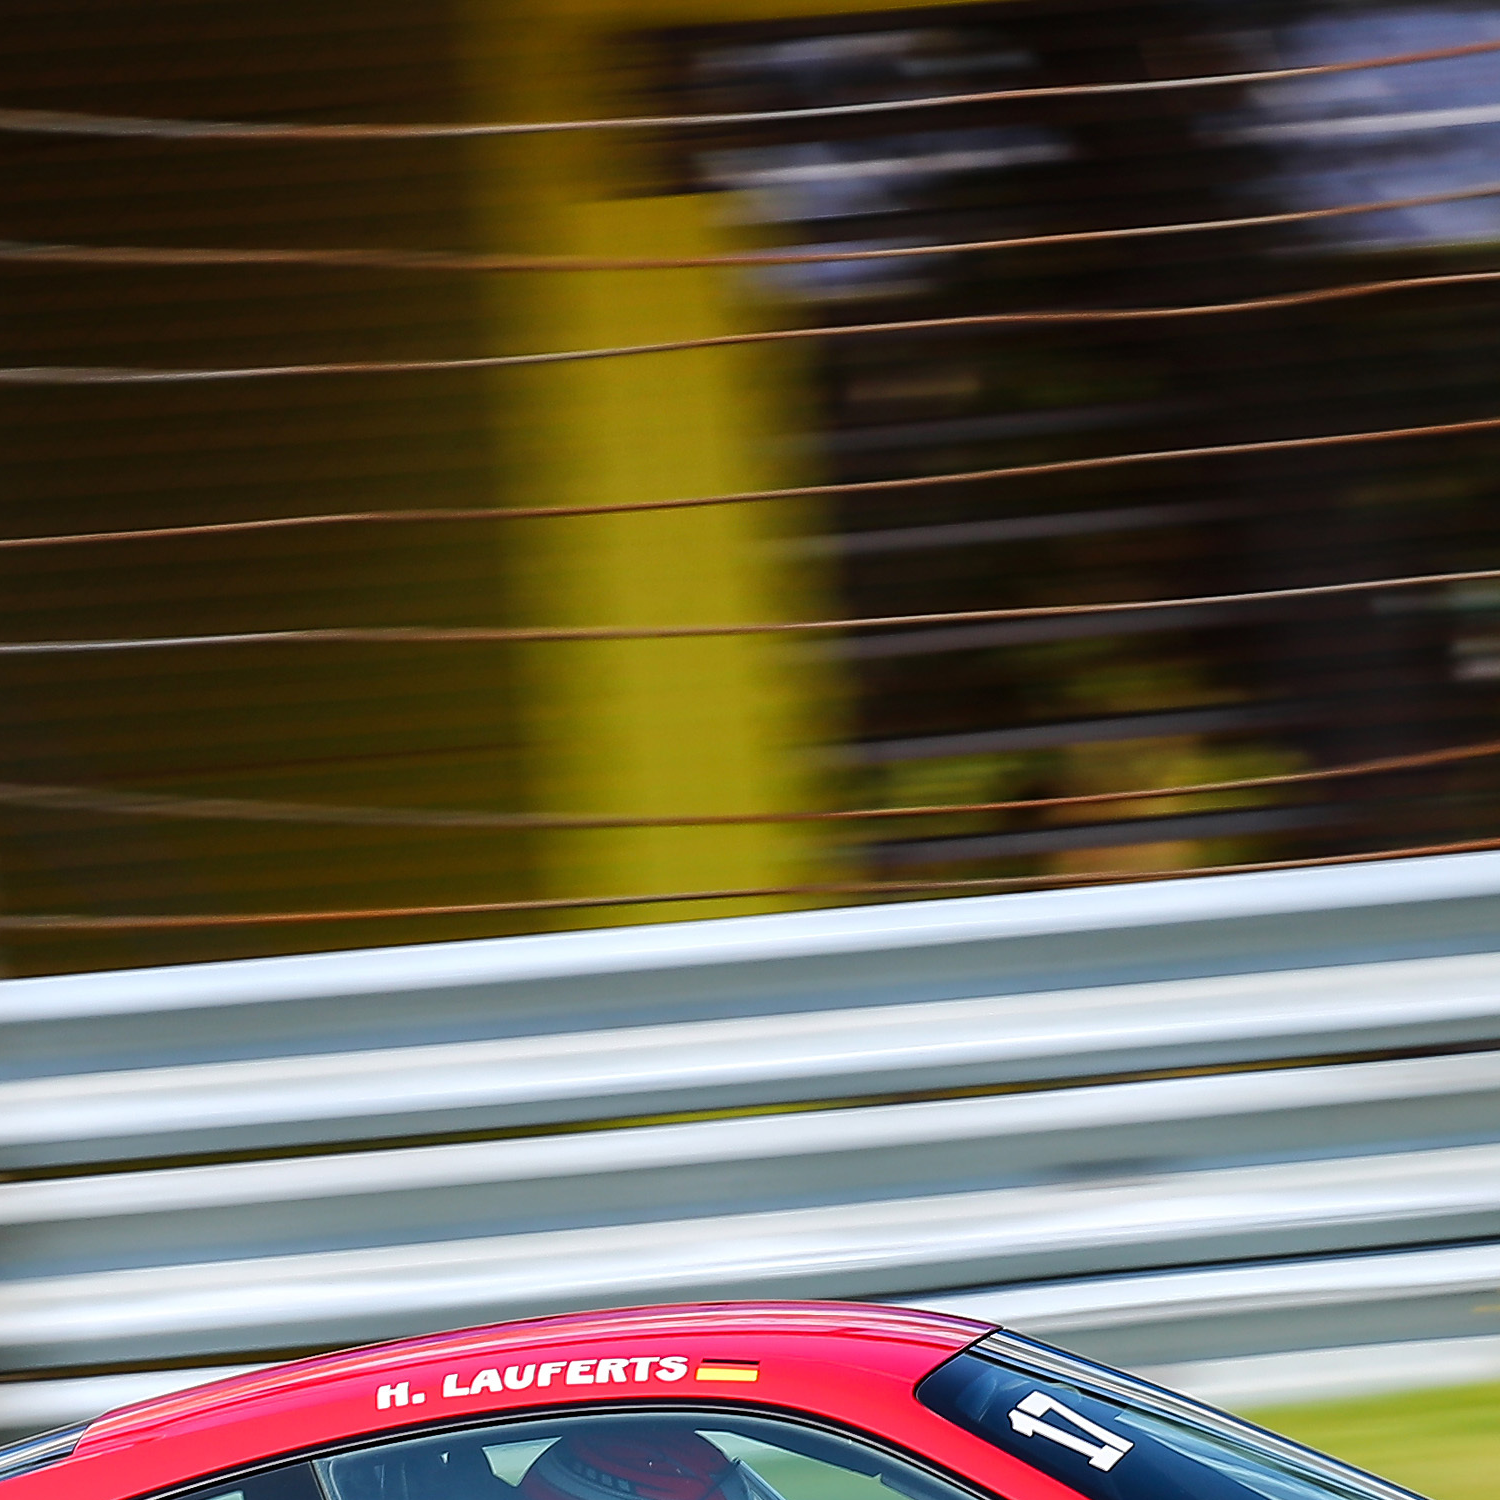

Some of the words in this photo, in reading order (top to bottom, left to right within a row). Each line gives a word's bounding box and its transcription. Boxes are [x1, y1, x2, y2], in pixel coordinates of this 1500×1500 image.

[377, 1382, 426, 1410] H.
[442, 1355, 690, 1399] LAUFERTS
[1007, 1390, 1135, 1473] 17
